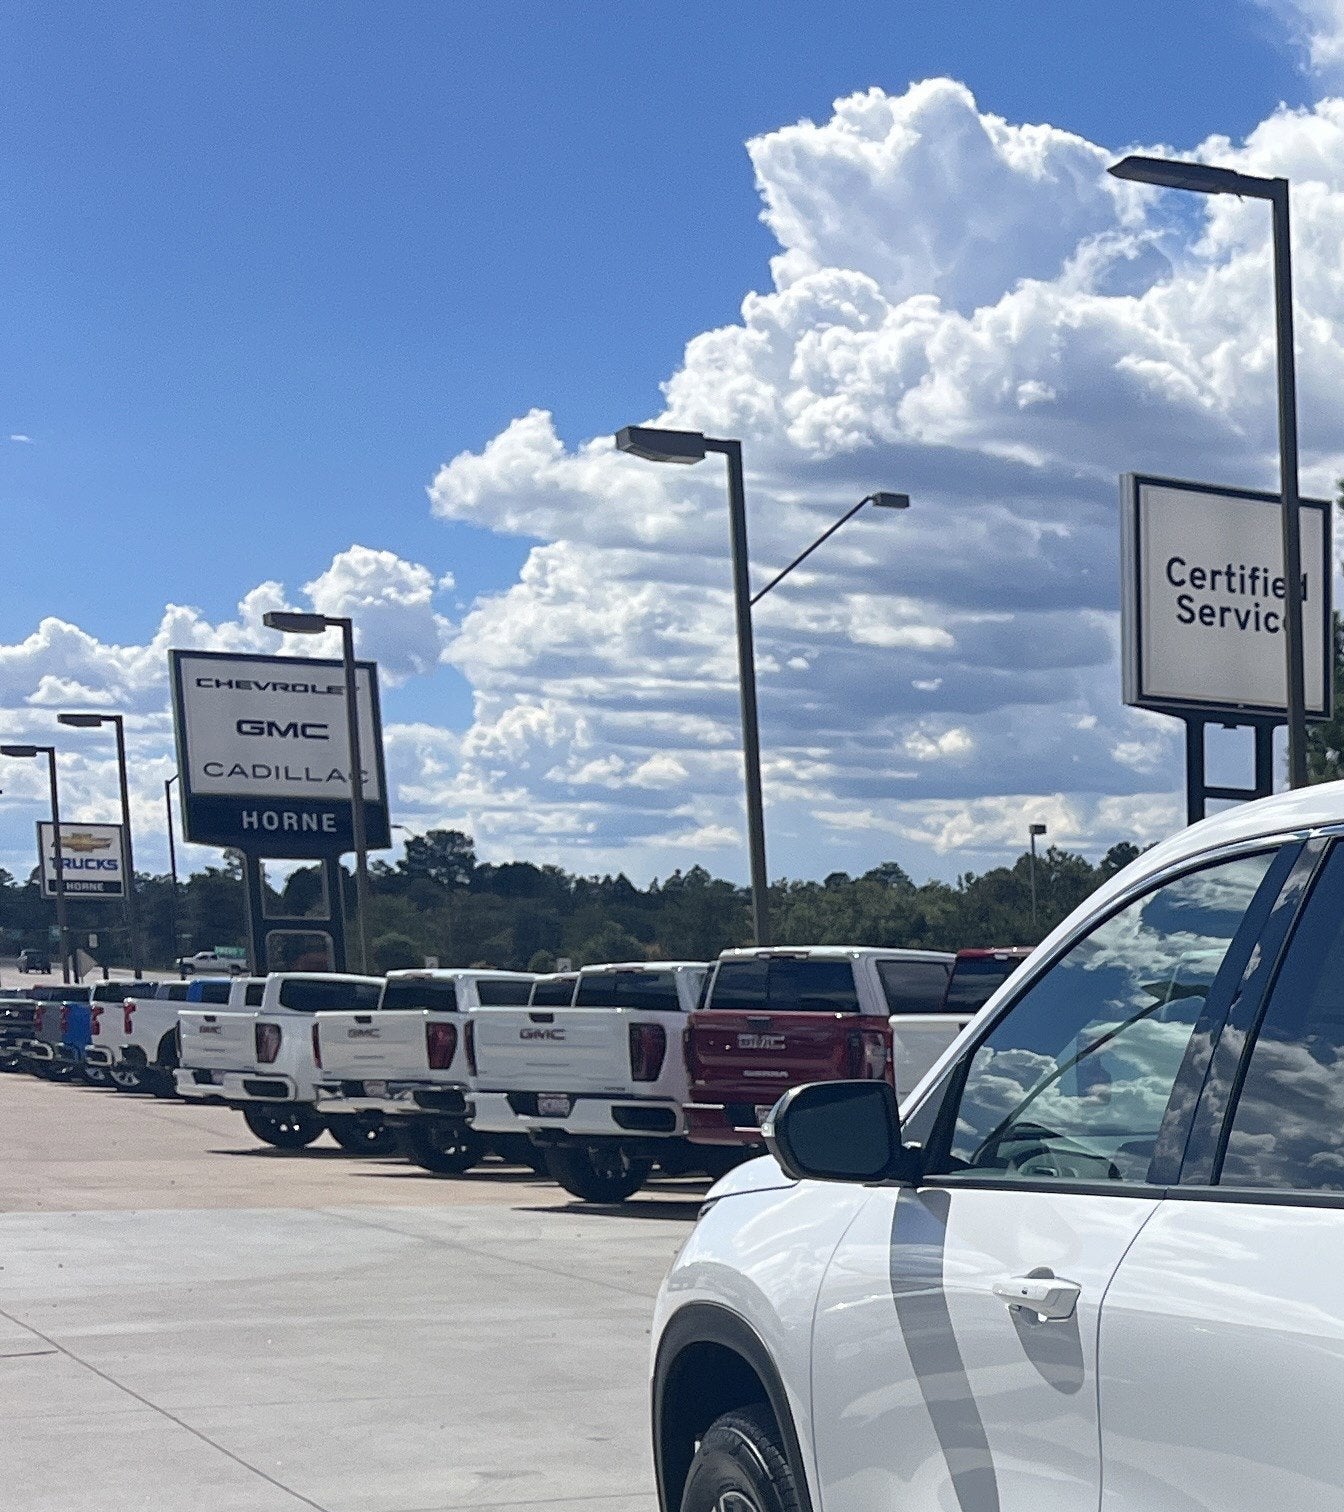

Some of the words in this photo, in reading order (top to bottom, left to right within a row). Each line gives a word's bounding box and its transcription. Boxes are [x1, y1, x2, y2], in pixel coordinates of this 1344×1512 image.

[1176, 594, 1288, 633] Servic
[195, 677, 359, 696] CHEVROLE
[236, 719, 329, 740] GMC
[242, 811, 337, 833] HORNE
[66, 882, 104, 892] HORNE
[519, 1028, 567, 1040] GMC
[737, 1033, 786, 1050] GMC
